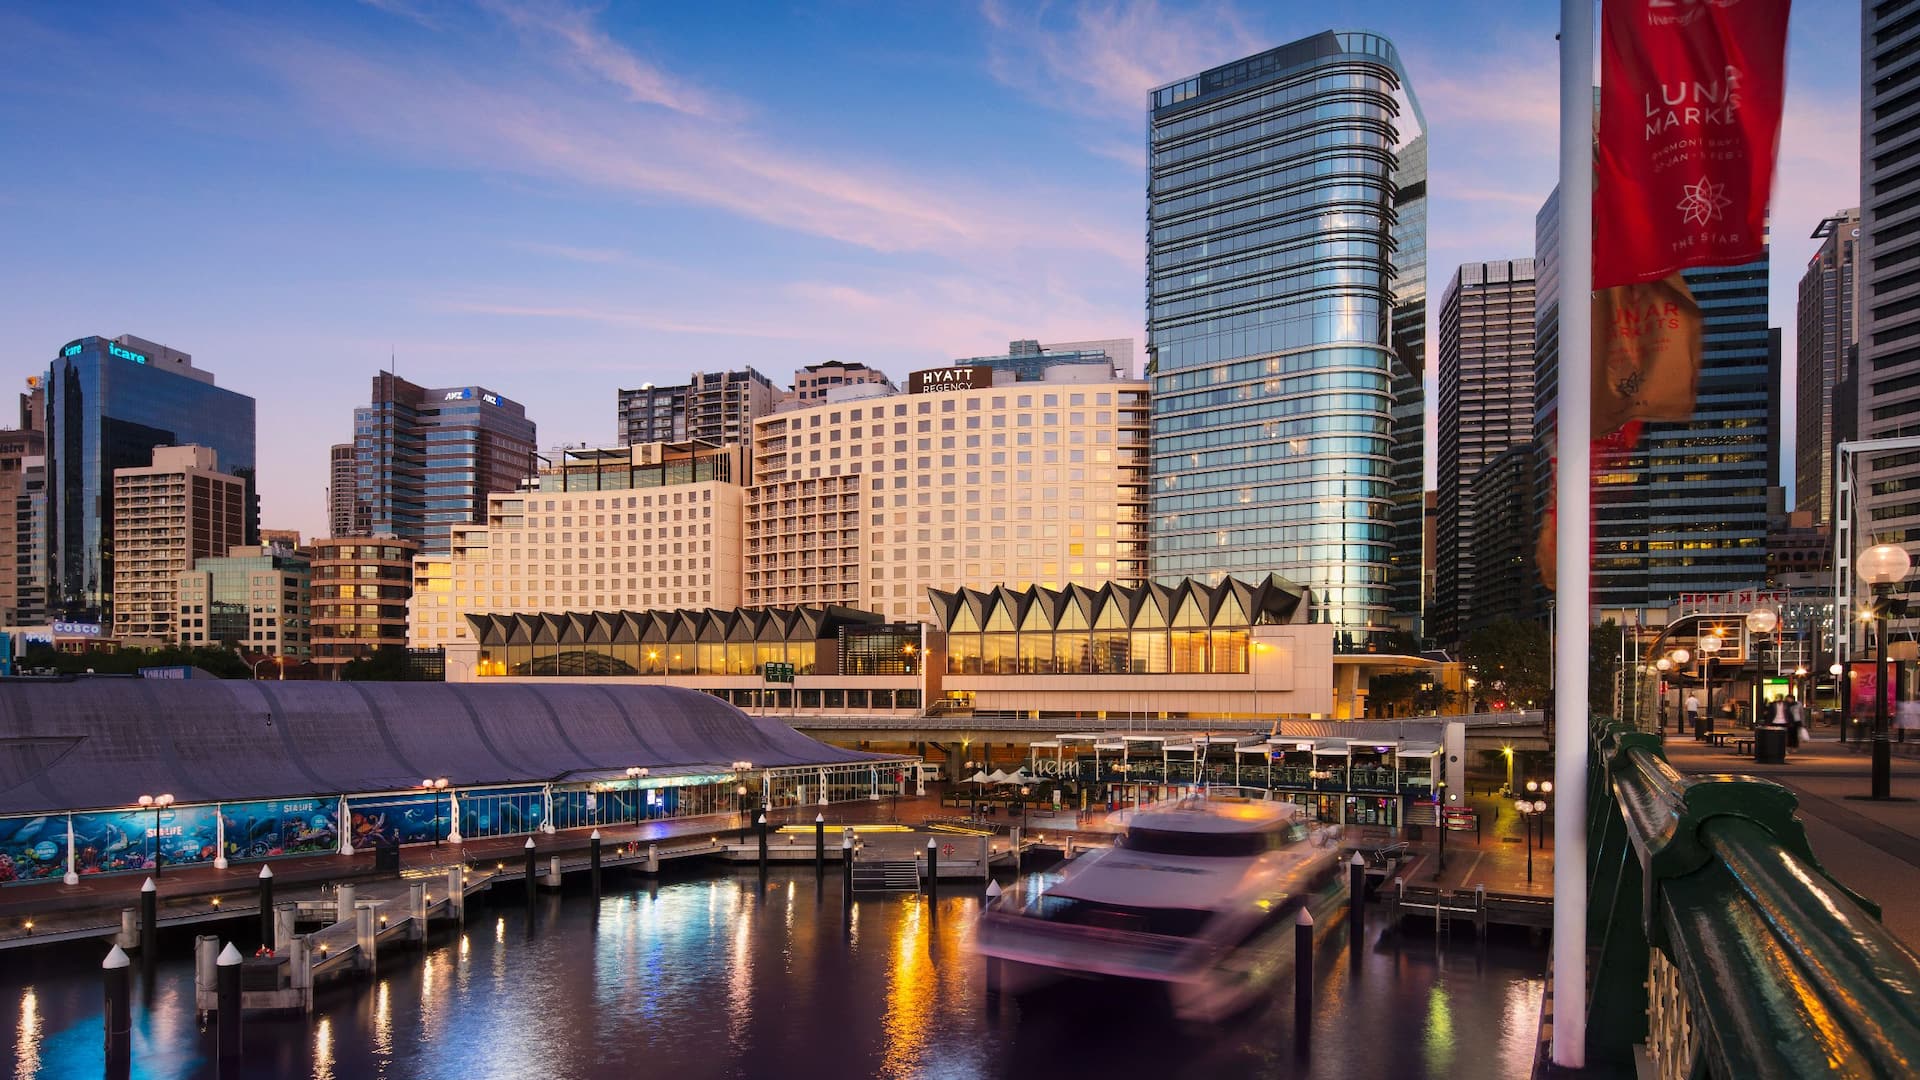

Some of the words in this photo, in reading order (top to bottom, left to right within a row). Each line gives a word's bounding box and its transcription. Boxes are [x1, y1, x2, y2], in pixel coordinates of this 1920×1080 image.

[1672, 236, 1694, 253] THE
[1700, 231, 1739, 244] STAR
[109, 342, 146, 365] icare
[923, 369, 973, 384] HYATT
[923, 382, 973, 394] REGENCY
[1032, 755, 1080, 778] helm
[299, 802, 313, 812] LIFE
[166, 825, 184, 837] LIFE
